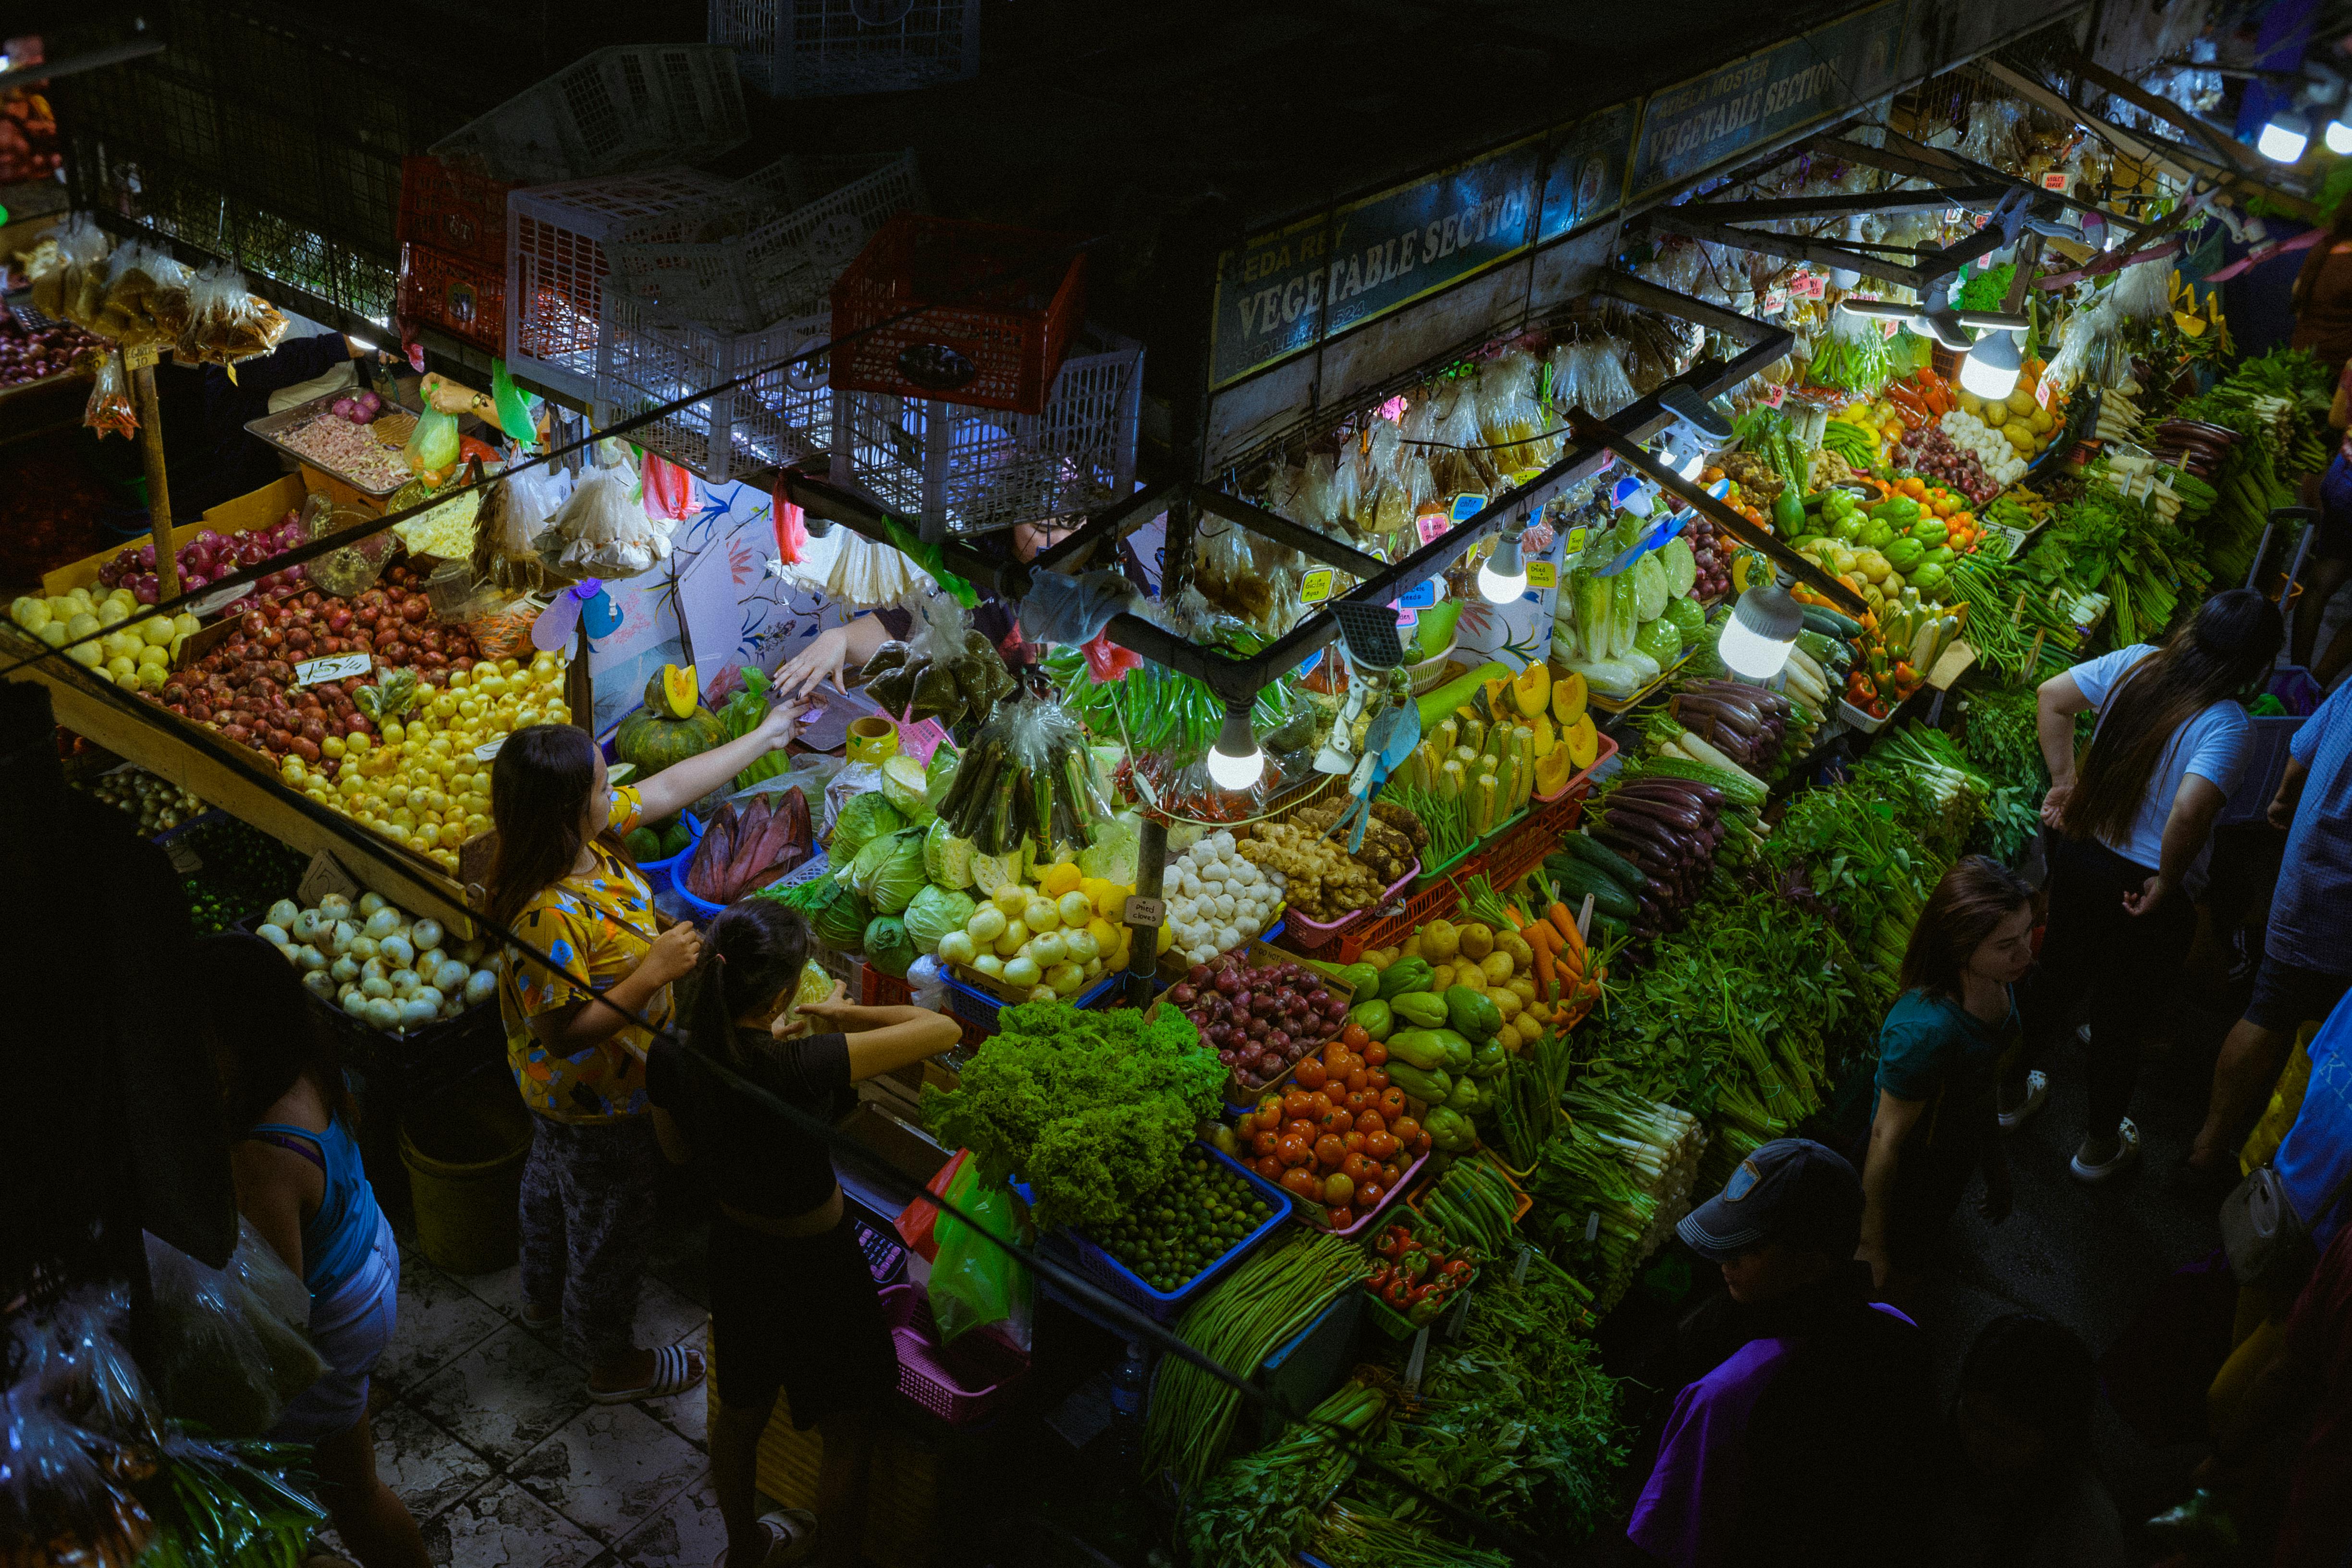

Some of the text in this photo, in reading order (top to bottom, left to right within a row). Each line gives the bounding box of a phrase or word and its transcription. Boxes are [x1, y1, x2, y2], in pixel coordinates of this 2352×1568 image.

[1650, 87, 1763, 167] VEGETABLE
[1763, 54, 1843, 117] SECTION
[1237, 180, 1538, 340] VEGETABLE SECTION
[1332, 300, 1365, 329] 524
[307, 658, 342, 681] 15
[1133, 913, 1157, 922] cloves
[1259, 948, 1267, 956] DO
[1268, 951, 1280, 961] NOT
